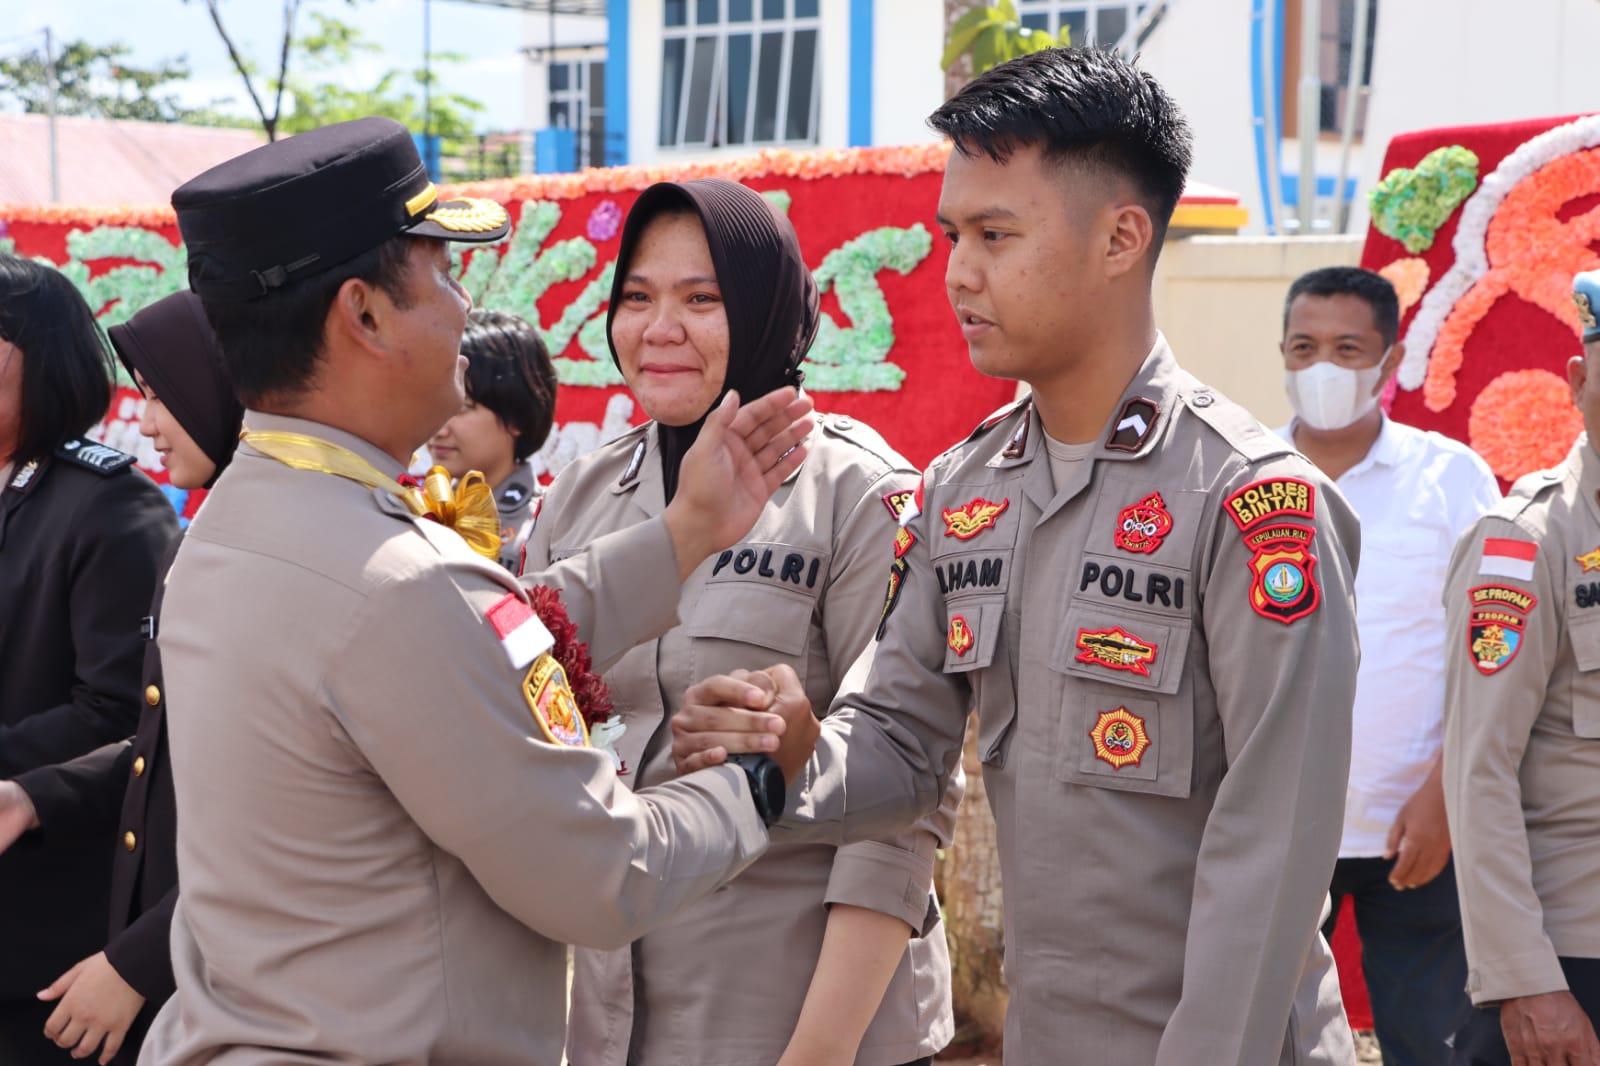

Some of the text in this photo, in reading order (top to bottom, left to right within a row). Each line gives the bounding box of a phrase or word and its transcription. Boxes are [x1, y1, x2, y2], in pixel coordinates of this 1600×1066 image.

[1231, 482, 1308, 512] POLRES
[1238, 496, 1308, 524] BINTAN
[712, 548, 820, 589] POLRI
[934, 557, 1003, 594] LHAM
[1079, 560, 1184, 609] POLRI
[1488, 587, 1532, 610] PROPAM
[1478, 612, 1519, 625] PROPAM
